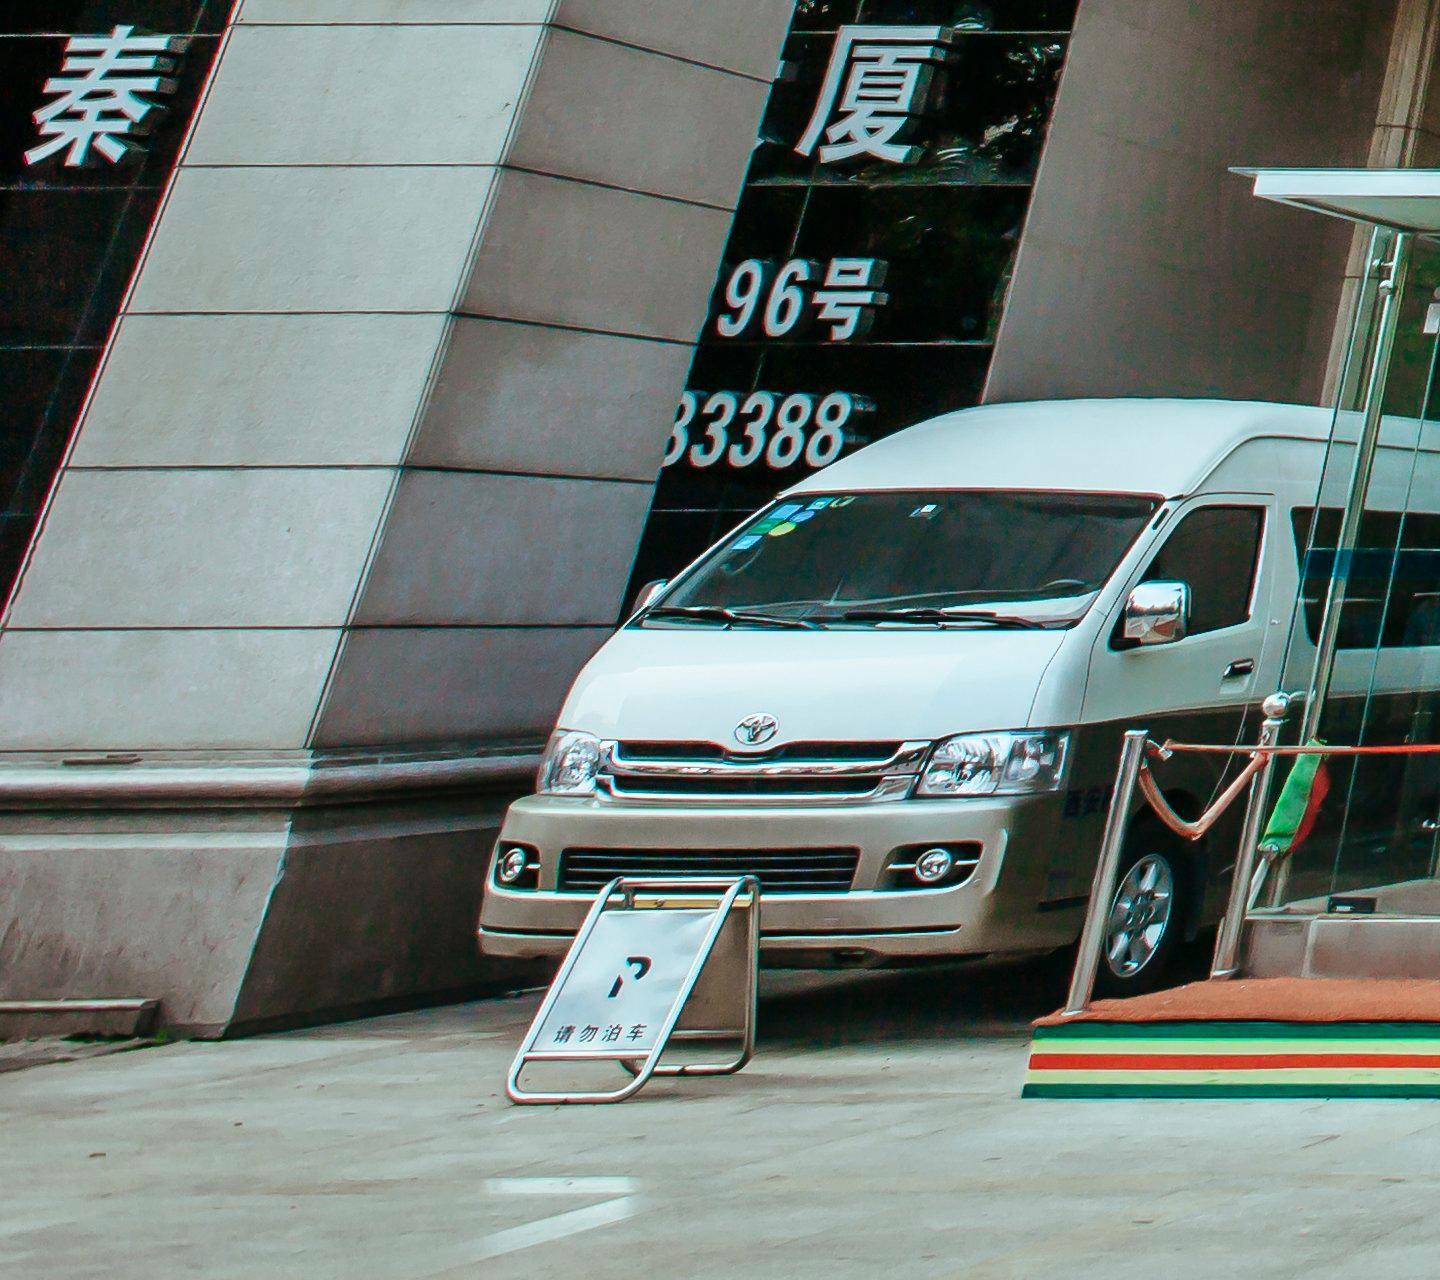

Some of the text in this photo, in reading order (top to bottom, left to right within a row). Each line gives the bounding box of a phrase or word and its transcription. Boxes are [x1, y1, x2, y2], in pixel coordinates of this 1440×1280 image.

[23, 24, 170, 167] 秦
[794, 25, 943, 164] 厦
[716, 257, 876, 341] 96号
[553, 1023, 648, 1043] 请勿泊车
